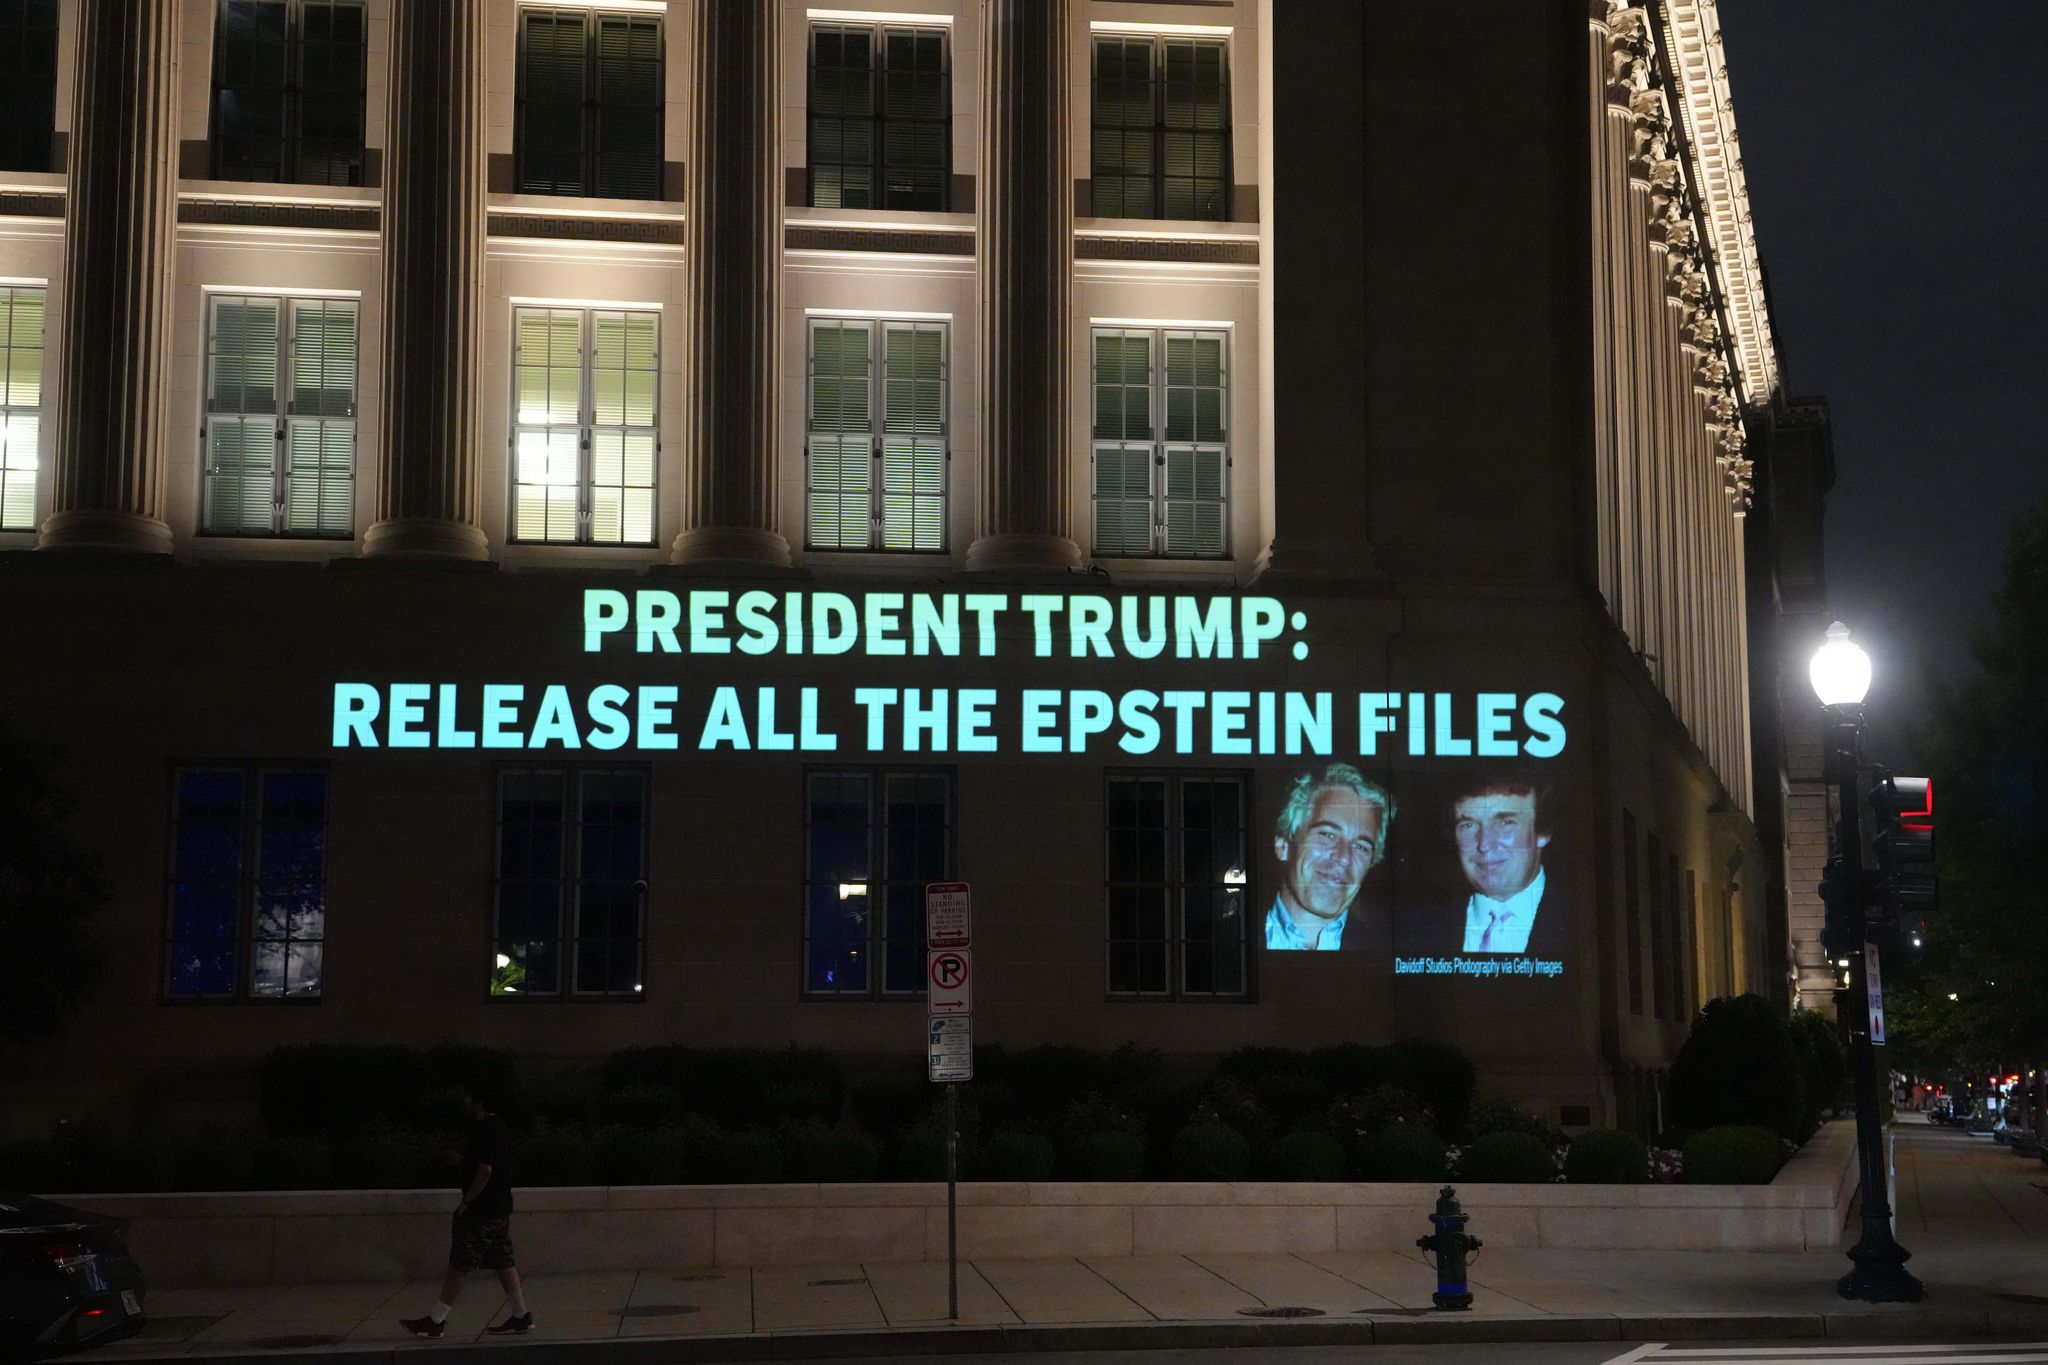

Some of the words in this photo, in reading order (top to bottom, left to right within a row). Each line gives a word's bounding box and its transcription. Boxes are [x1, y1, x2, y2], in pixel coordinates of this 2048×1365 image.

[584, 589, 1008, 657] PRESIDENT
[1021, 594, 1309, 661] TRUMP:
[332, 682, 679, 751] RELEASE
[698, 686, 837, 751] ALL
[854, 687, 998, 752] THE
[1022, 689, 1333, 756] EPSTEIN
[1359, 692, 1567, 758] FILES
[1395, 957, 1425, 974] Davidoff
[1425, 957, 1453, 974] Studios
[1453, 957, 1500, 977] Photography
[1501, 957, 1513, 974] via
[1513, 957, 1534, 977] Getty
[1534, 958, 1563, 977] Images
